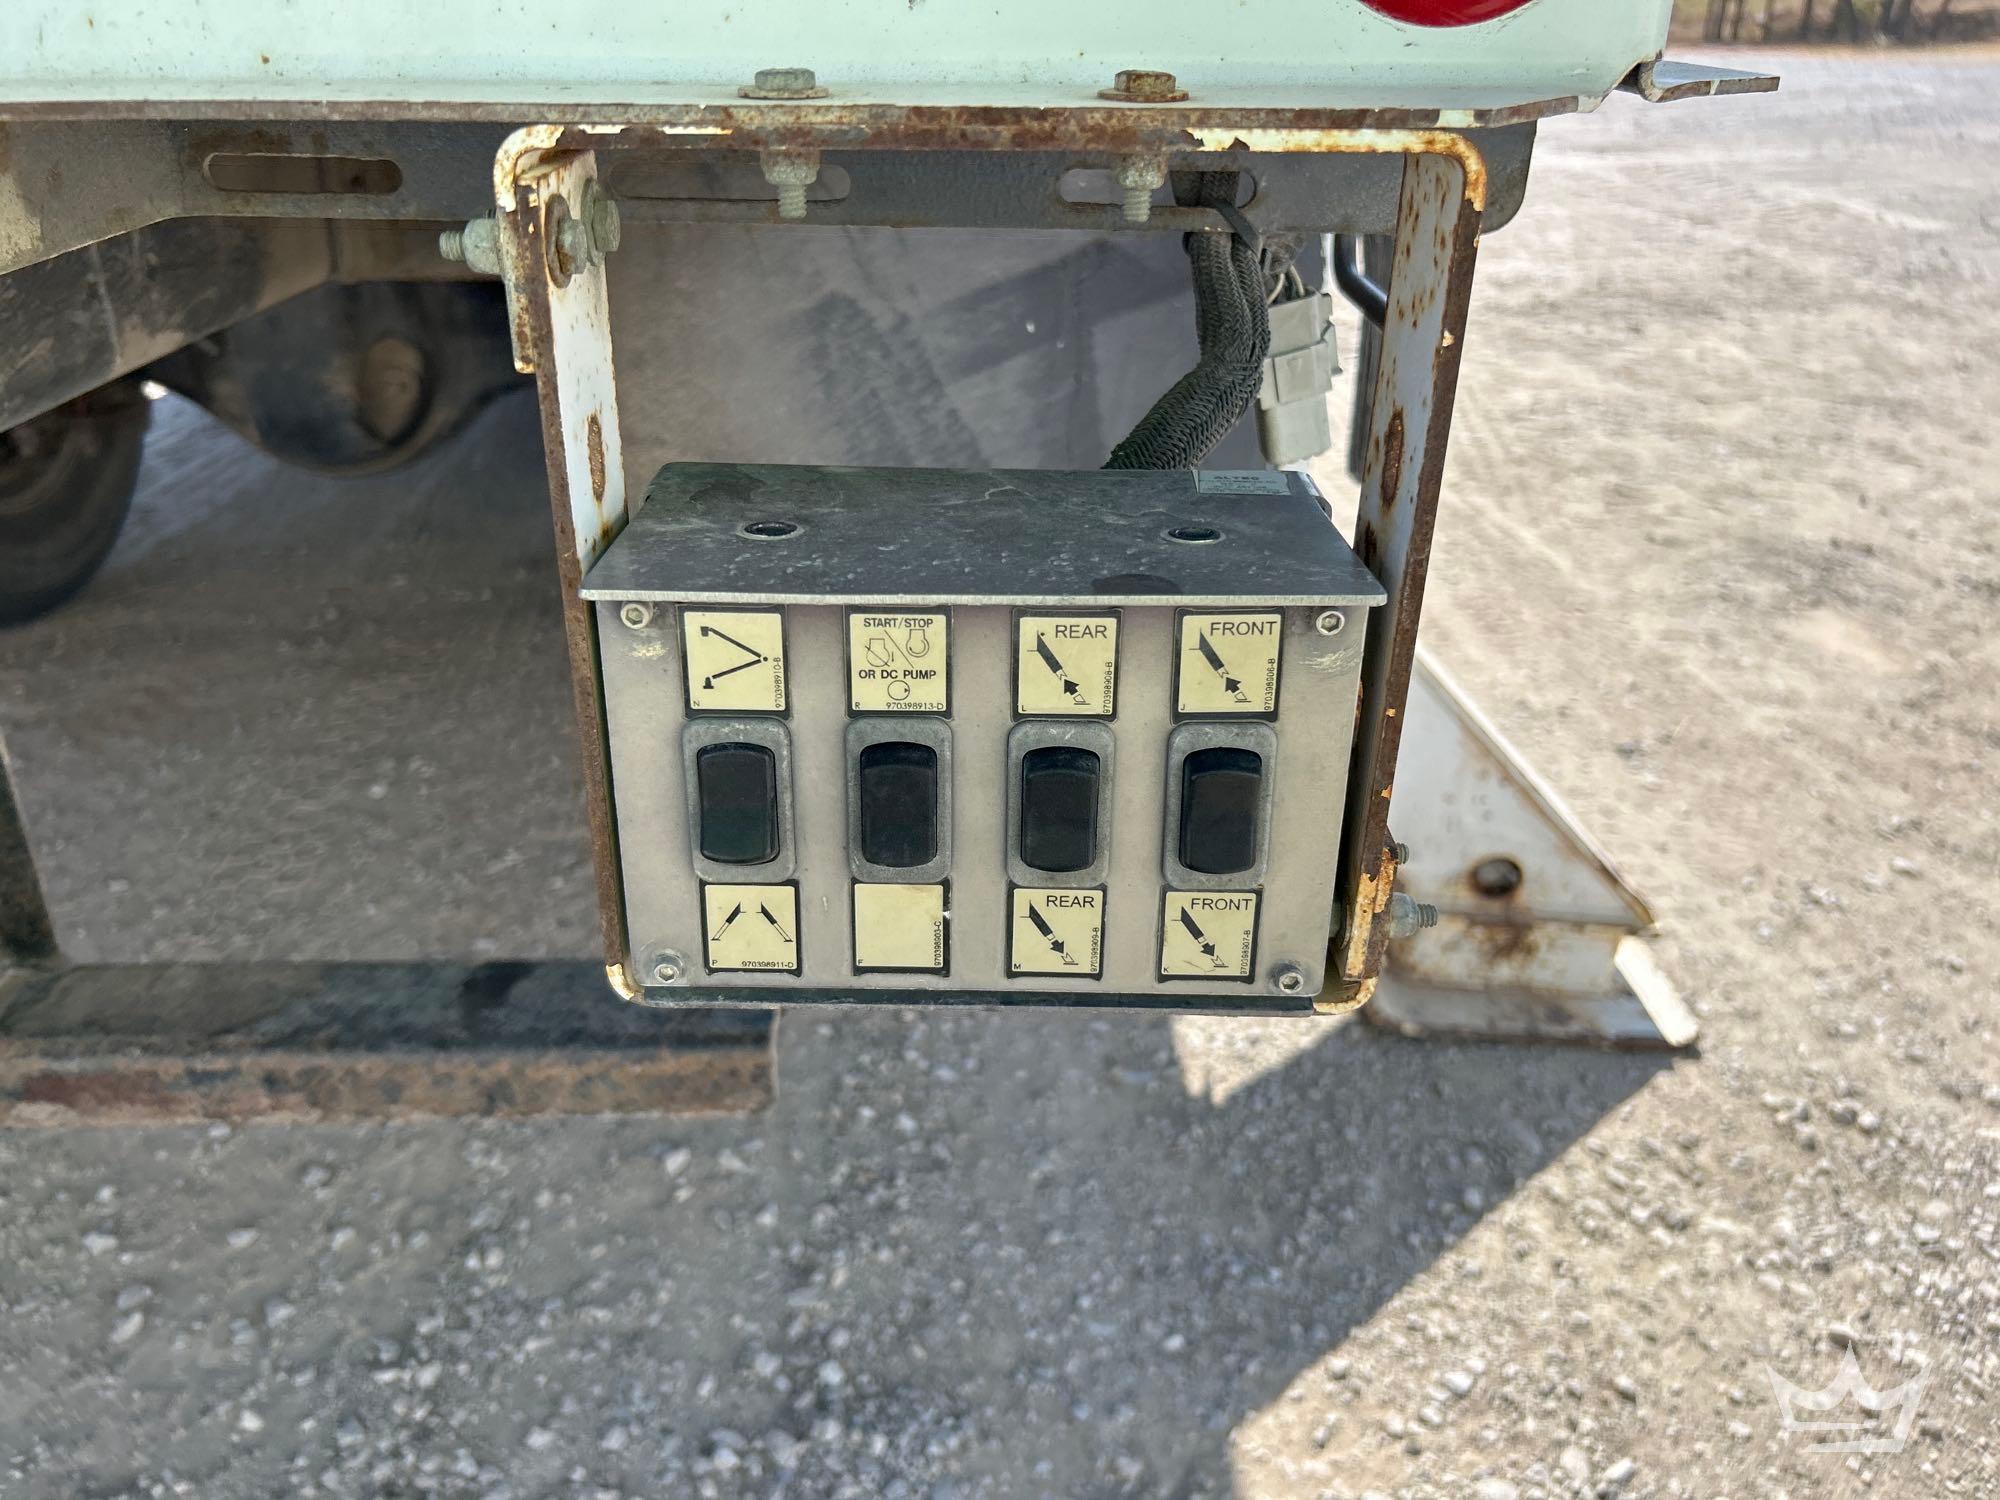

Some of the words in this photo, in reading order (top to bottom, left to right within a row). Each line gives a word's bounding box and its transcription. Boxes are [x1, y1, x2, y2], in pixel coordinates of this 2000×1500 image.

[1055, 624, 1107, 639] REAR
[1210, 621, 1277, 636] FRONT
[858, 669, 876, 680] OR
[881, 669, 898, 680] DC
[903, 669, 936, 680] PUMP
[854, 702, 861, 710] R
[886, 702, 944, 710] 970398913-D
[1021, 704, 1027, 712] L
[1046, 895, 1095, 908] REAR
[1191, 897, 1253, 911] FRONT
